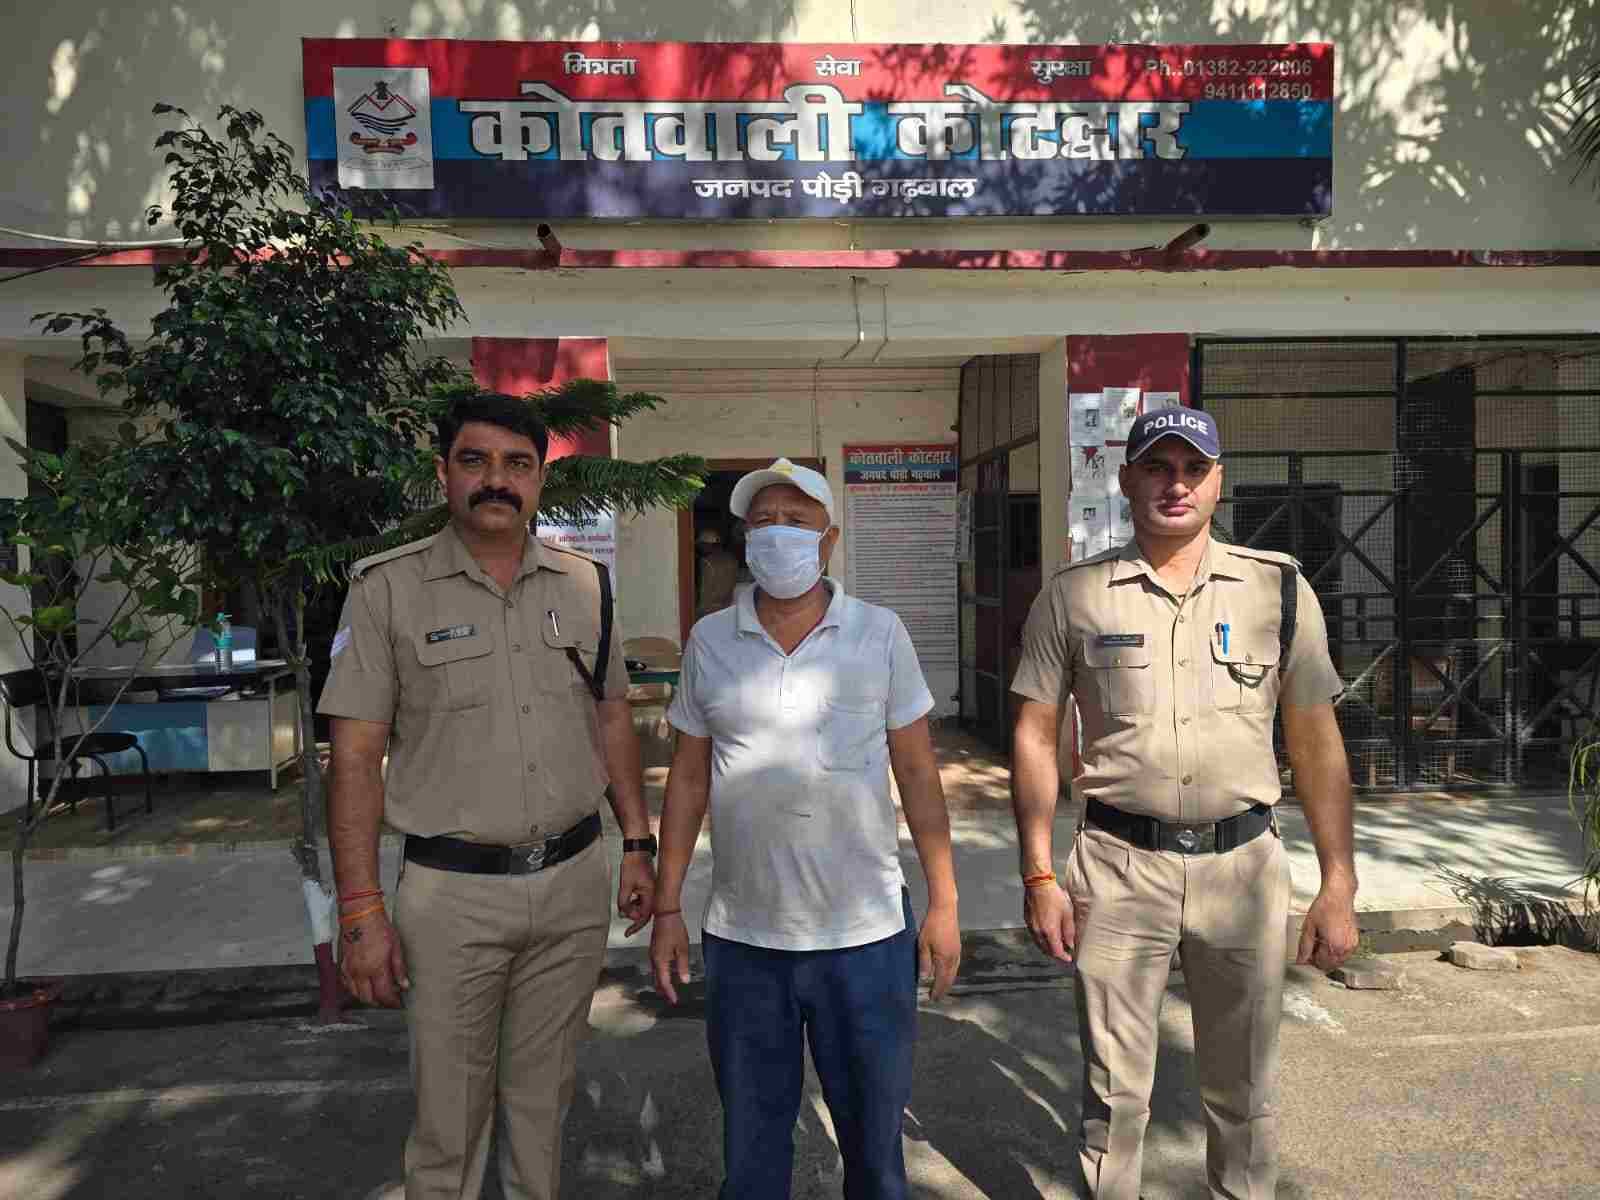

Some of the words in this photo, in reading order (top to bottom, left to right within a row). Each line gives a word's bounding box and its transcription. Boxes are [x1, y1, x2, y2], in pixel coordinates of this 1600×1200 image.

[562, 51, 638, 76] मित्रता
[815, 54, 862, 77] सेवा
[1031, 60, 1092, 85] सुरक्षा
[459, 82, 863, 161] कोतवाली
[887, 83, 1191, 161] कोटद्वार
[692, 178, 795, 199] जनपद
[801, 171, 864, 204] पौड़ी
[871, 178, 978, 202] गढ़वाल
[1143, 413, 1209, 436] POLICE
